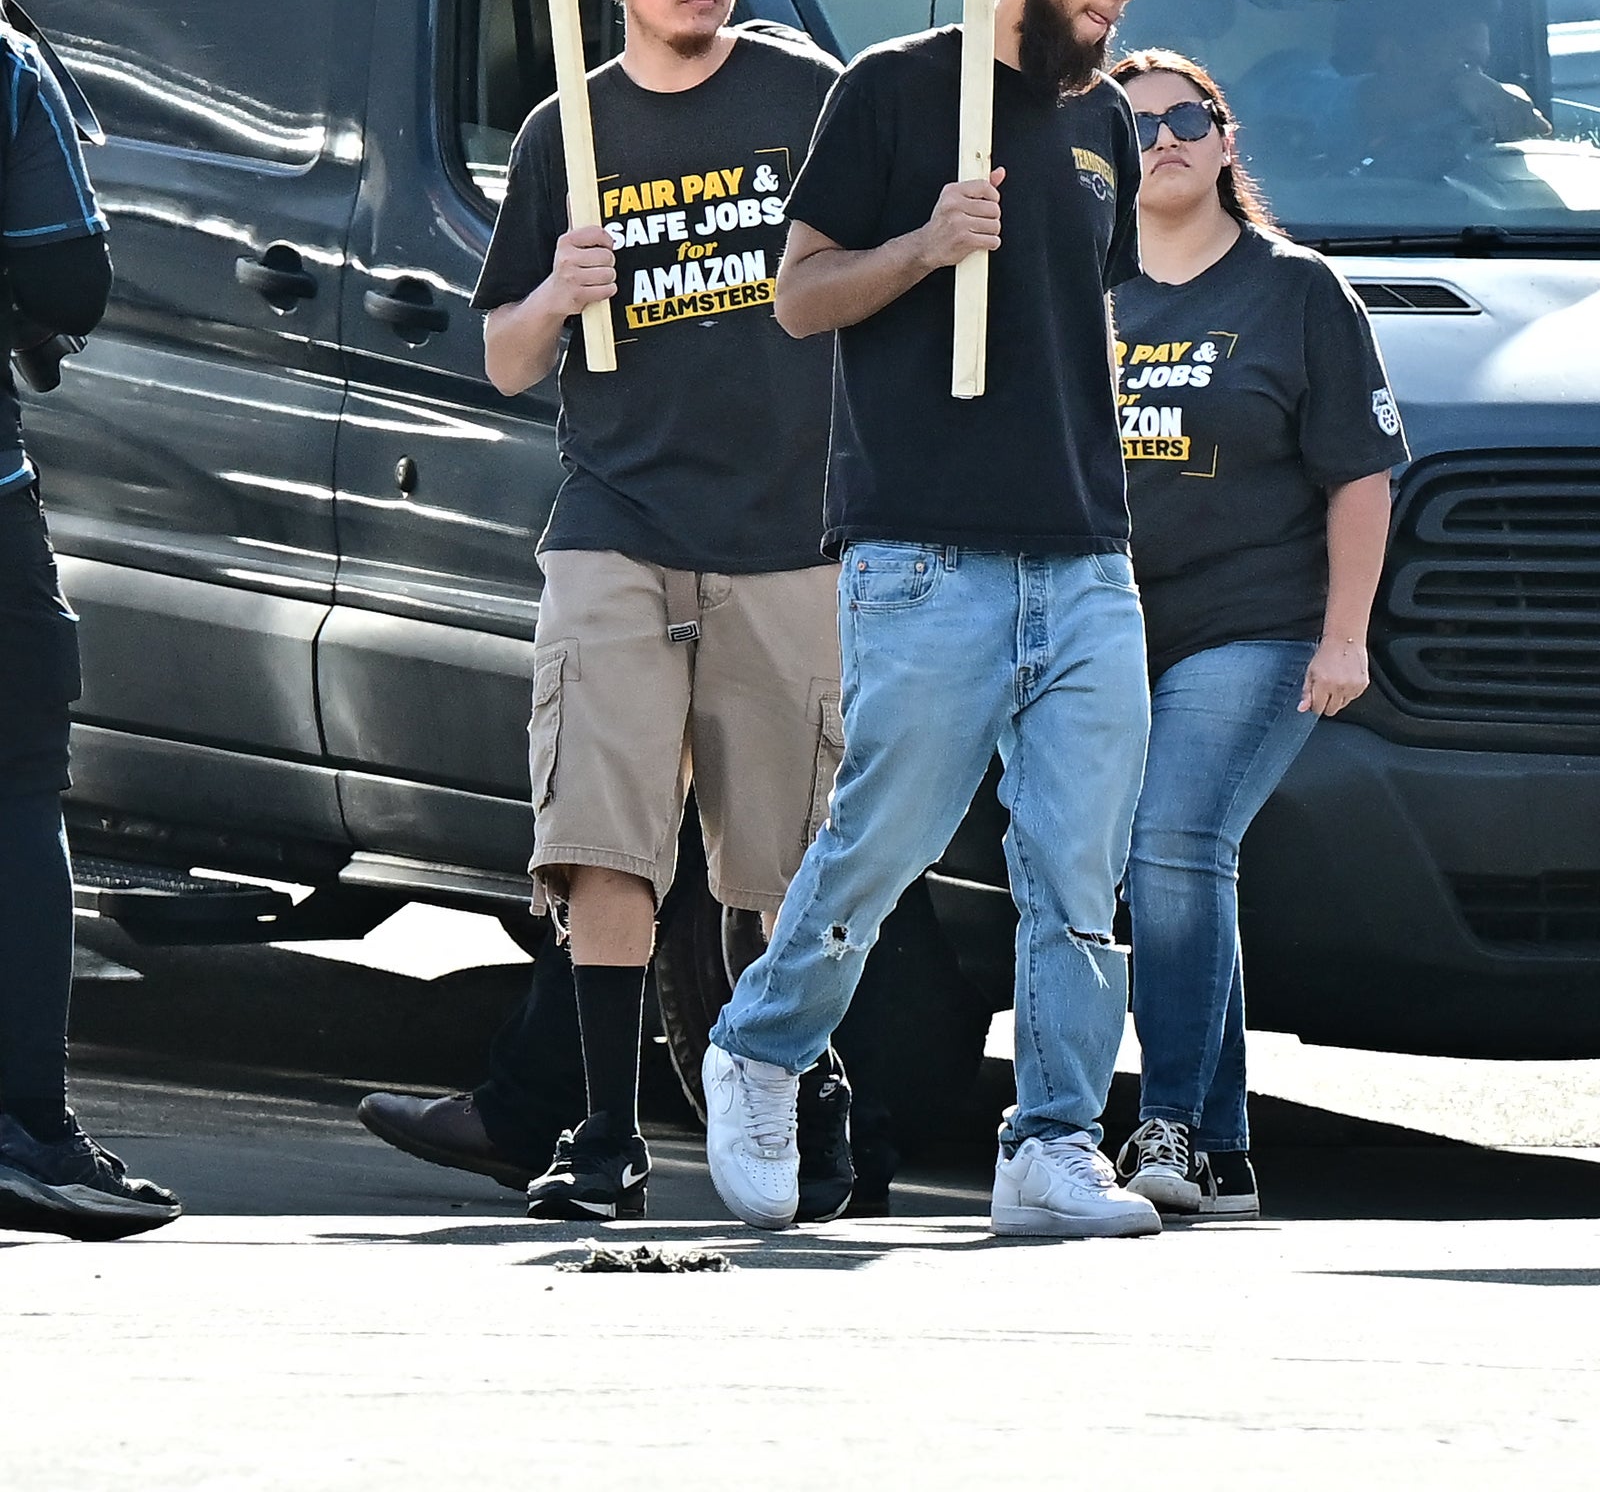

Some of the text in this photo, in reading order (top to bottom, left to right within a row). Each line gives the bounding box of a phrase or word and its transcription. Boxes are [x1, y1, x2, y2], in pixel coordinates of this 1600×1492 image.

[603, 164, 779, 218] FAIR PAY &
[603, 196, 785, 251] SAFE JOBS
[676, 241, 718, 261] for
[632, 249, 767, 305] AMAZON
[631, 282, 770, 324] TEAMSTERS
[1129, 341, 1192, 365] PAY
[1192, 341, 1219, 363] &
[1126, 364, 1213, 390] JOBS
[1117, 393, 1141, 406] or
[1121, 405, 1183, 438] ZON
